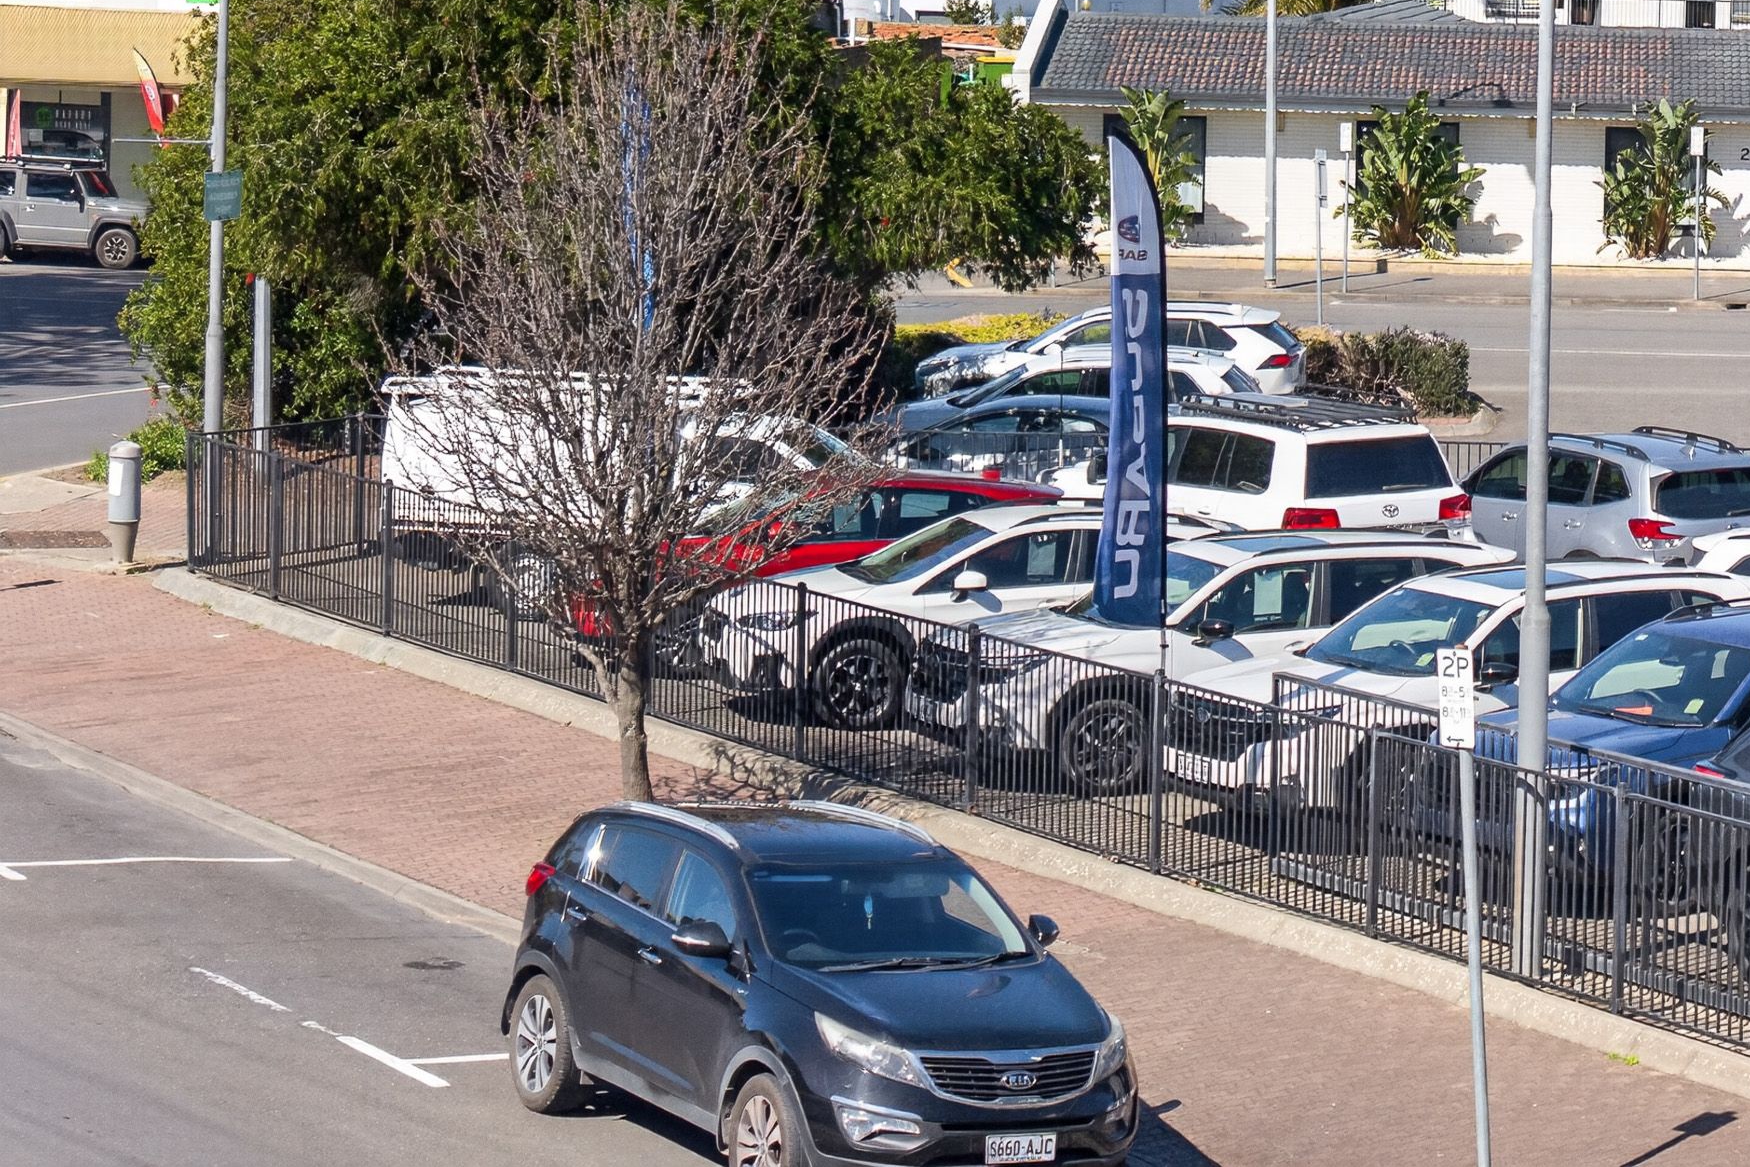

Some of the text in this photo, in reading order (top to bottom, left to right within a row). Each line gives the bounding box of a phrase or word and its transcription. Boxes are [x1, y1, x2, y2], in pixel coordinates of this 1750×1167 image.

[1740, 147, 1750, 161] 2
[1442, 656, 1469, 678] 2P
[1008, 1073, 1033, 1087] KIA
[989, 1137, 1054, 1158] S660-AJC
